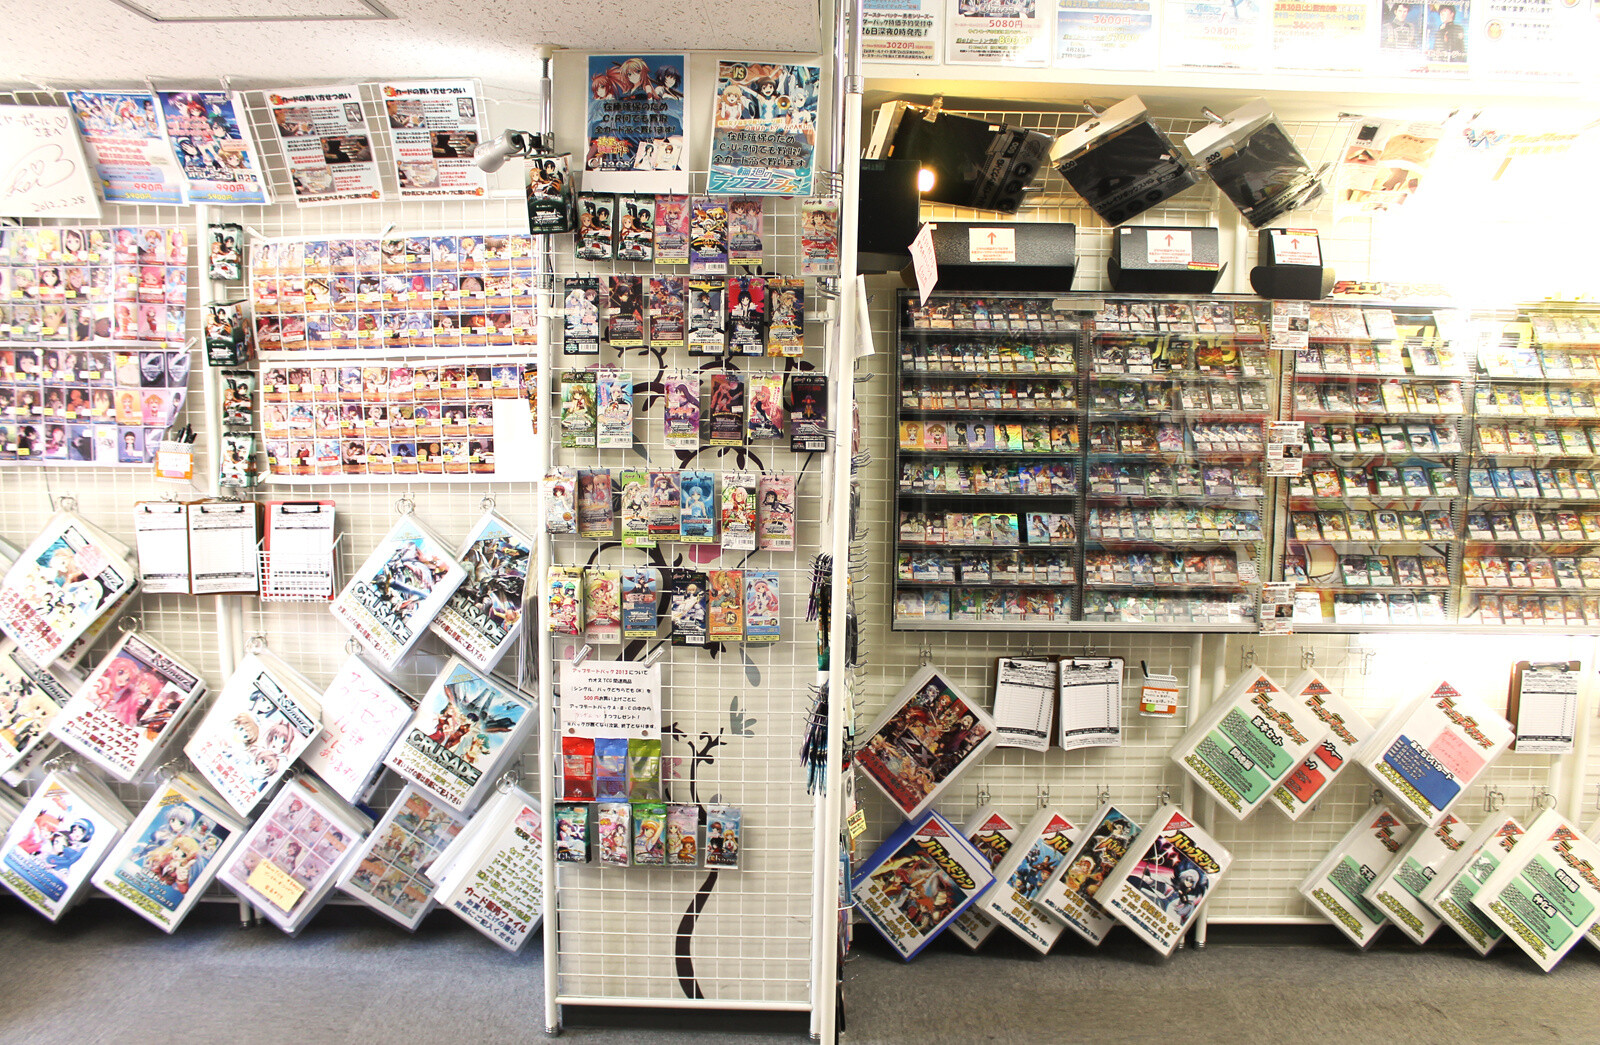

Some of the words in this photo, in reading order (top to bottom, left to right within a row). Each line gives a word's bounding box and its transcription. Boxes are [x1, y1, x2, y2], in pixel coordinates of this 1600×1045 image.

[989, 19, 1023, 28] 5080円
[886, 41, 914, 49] 3020円
[603, 102, 668, 112] 在庫確保のため
[728, 131, 795, 144] 在庫確保のため
[350, 580, 414, 643] CRUSADE
[1251, 715, 1286, 749] 基本セット
[408, 728, 482, 784] CRUSADE
[1409, 740, 1454, 782] あたらしいカード
[485, 865, 542, 908] コミックドラゴン
[453, 900, 519, 947] 用紙にご記入ください
[464, 885, 528, 934] カード販売ファイル
[466, 898, 518, 936] お買い上げの際は
